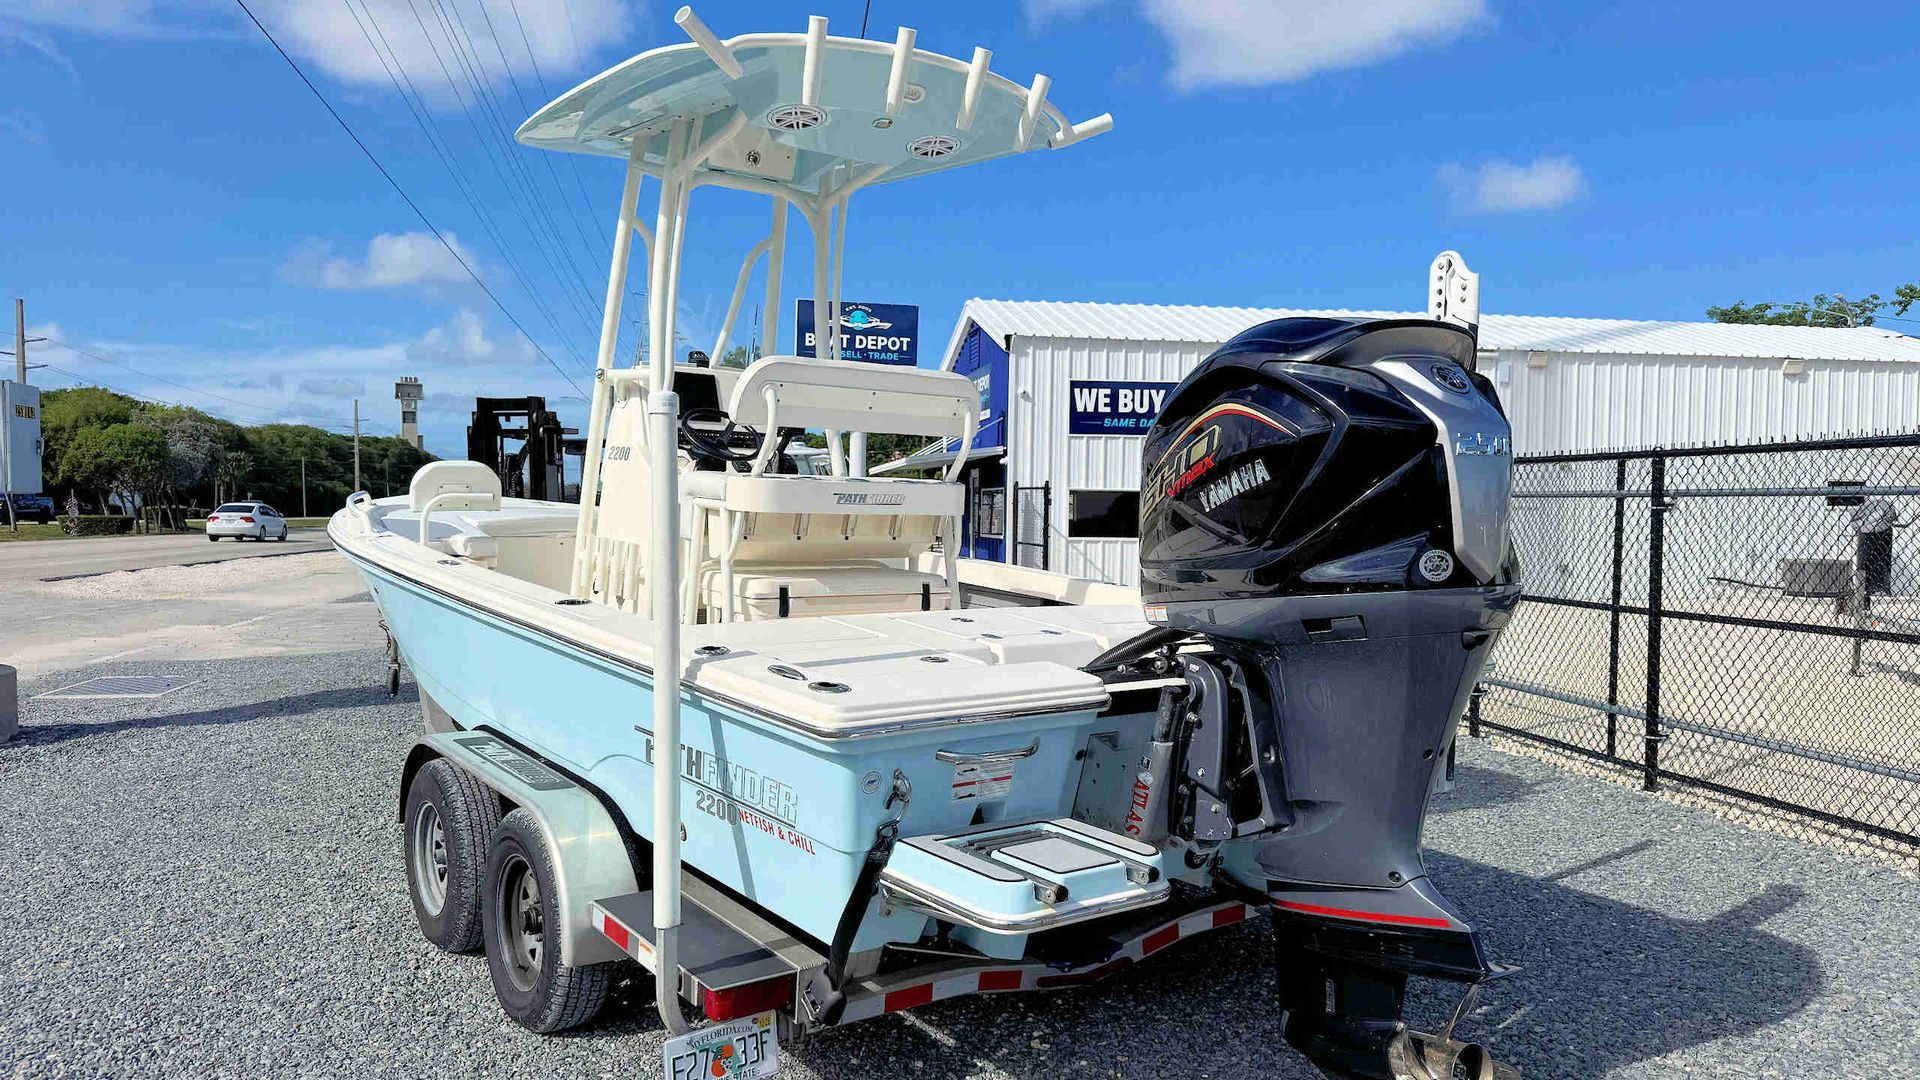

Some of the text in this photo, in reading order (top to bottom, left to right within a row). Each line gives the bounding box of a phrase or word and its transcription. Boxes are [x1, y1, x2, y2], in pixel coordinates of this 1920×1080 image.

[805, 332, 911, 351] BT DEPOT
[840, 351, 899, 361] SELL TRADE
[1073, 388, 1166, 414] WE BUY
[1103, 418, 1137, 428] SAME
[608, 445, 631, 461] 2200
[1198, 458, 1272, 513] YAMAHA
[695, 789, 739, 827] 2200
[1124, 776, 1151, 837] ATLAS
[738, 808, 817, 856] NETFISH & CHILL
[734, 1028, 770, 1069] 33F
